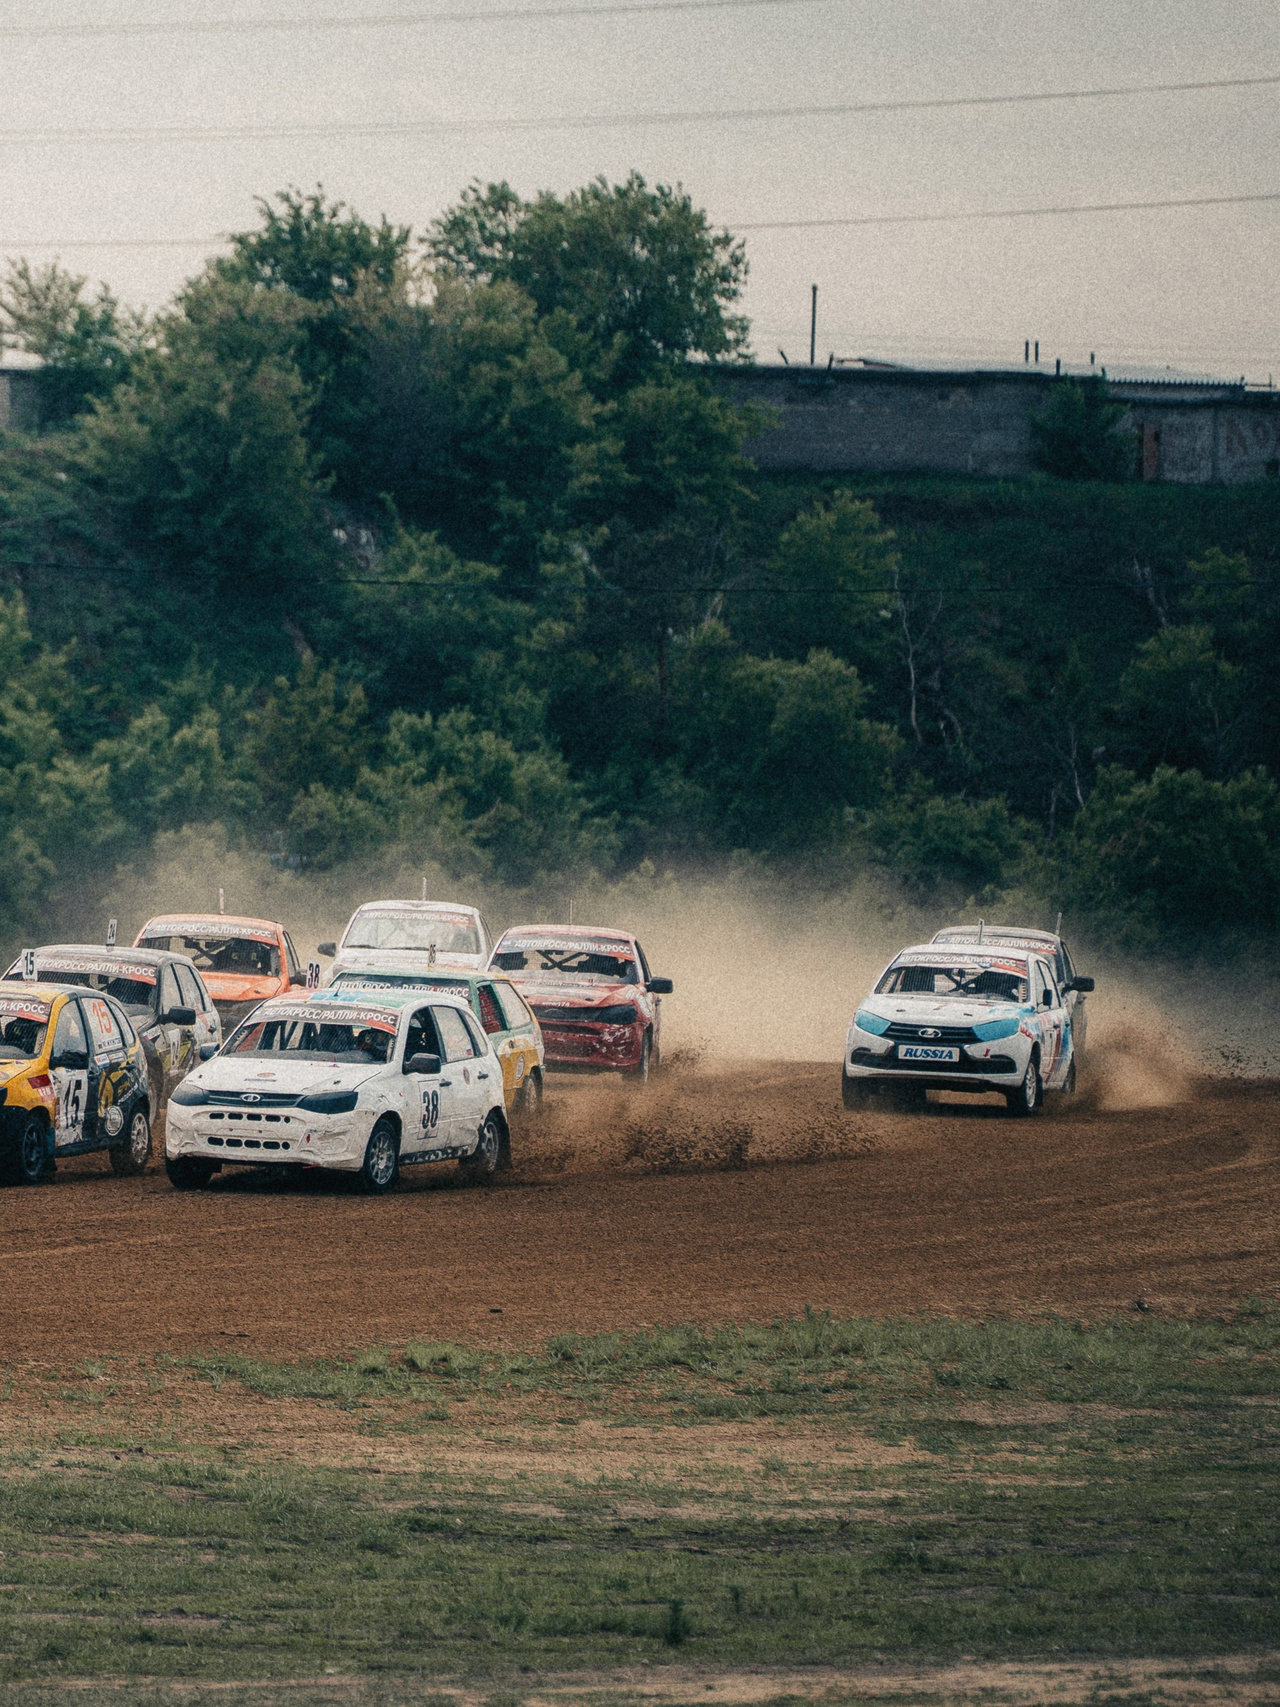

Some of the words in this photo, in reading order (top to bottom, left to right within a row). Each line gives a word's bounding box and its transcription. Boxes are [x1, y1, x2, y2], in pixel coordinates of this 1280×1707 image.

[153, 924, 272, 938] АВТОКРОСС/РАЛЛИ-КРОСС
[514, 939, 632, 954] АВТОКРОСС/РАЛЛИ-КРОСС
[24, 951, 35, 976] 15
[308, 962, 321, 989] 38
[92, 1001, 113, 1035] 15
[264, 1007, 395, 1025] АВТОКРОСС/РАЛЛИ-КРОСС
[903, 1047, 954, 1060] RUSSIA
[421, 1089, 439, 1130] 38
